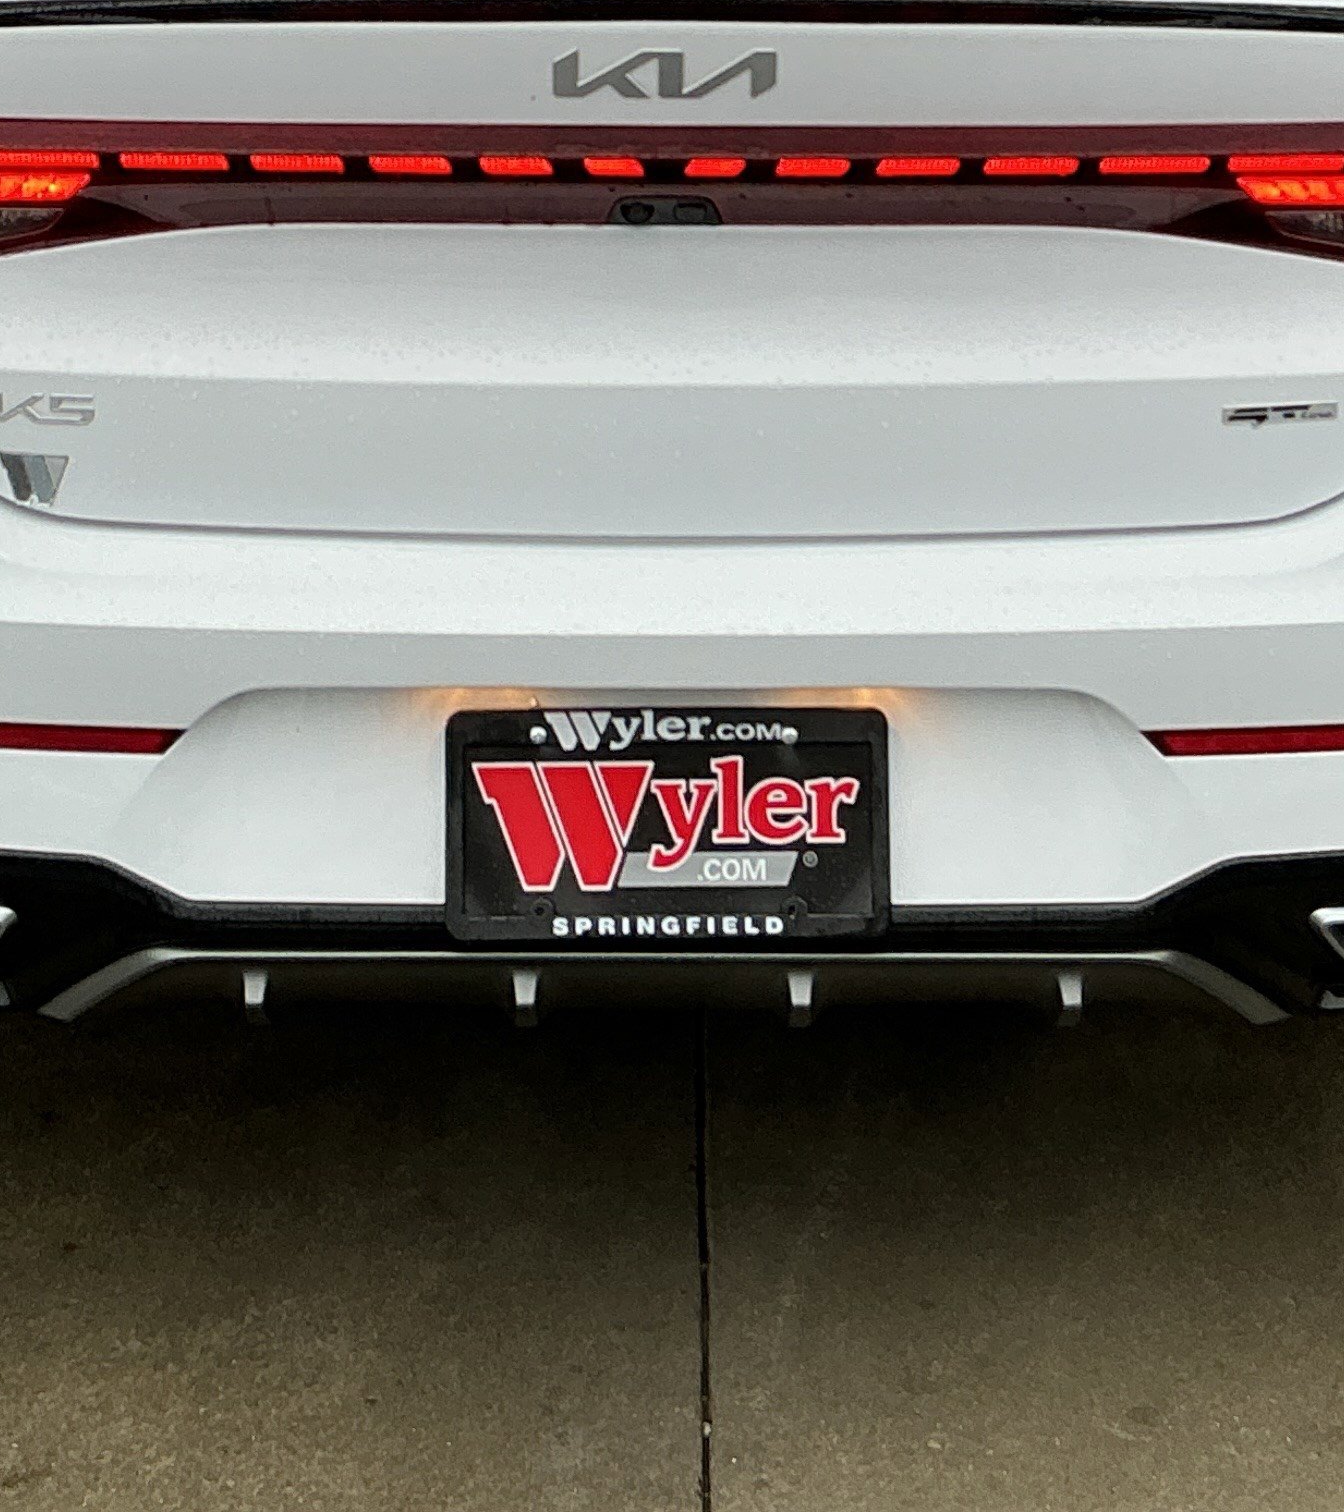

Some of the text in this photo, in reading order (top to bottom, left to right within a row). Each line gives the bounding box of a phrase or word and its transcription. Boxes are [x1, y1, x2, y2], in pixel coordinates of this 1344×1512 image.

[552, 48, 777, 99] KIA
[471, 755, 860, 892] Wyler
[696, 857, 768, 882] .COM
[551, 915, 785, 936] SPRINGFIELD
